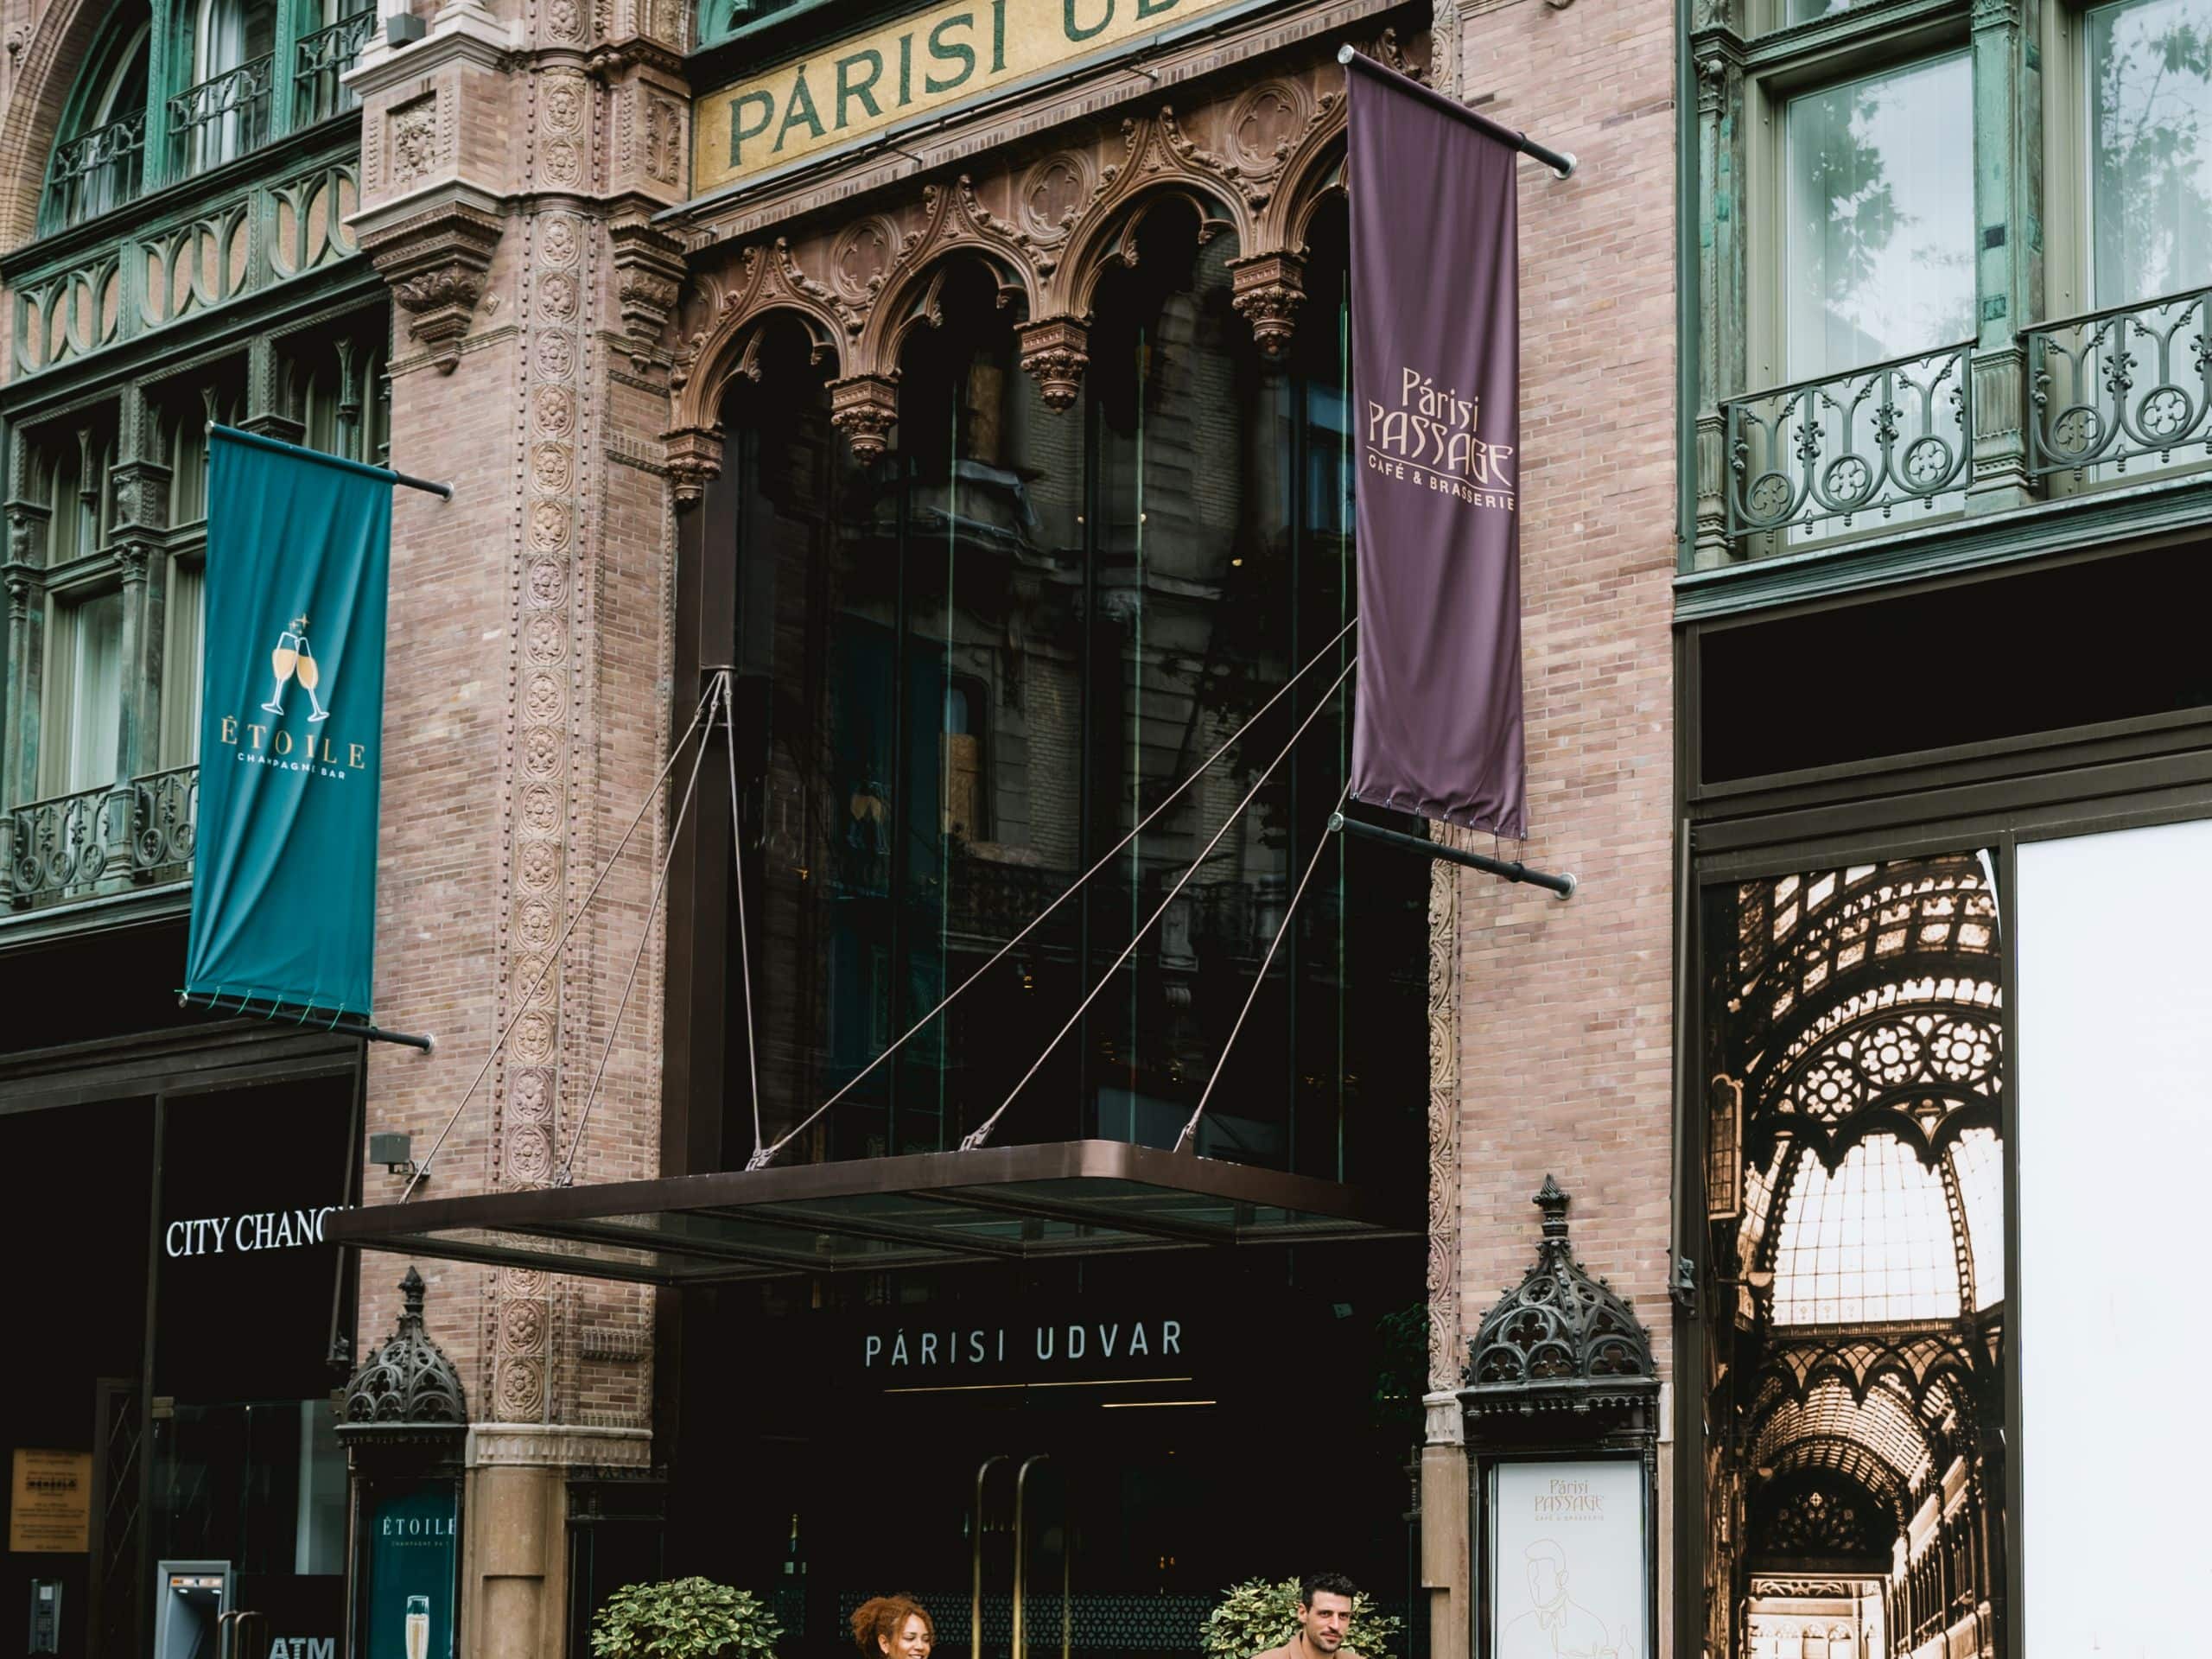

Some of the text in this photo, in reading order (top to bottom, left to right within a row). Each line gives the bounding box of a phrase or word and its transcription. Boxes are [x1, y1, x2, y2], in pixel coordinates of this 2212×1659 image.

[728, 0, 1007, 168] PÁRISI
[1402, 367, 1479, 433] Párisi
[1369, 398, 1514, 487] PASSAGE
[1368, 454, 1515, 512] CAFÉ & BRASSERIE
[321, 766, 346, 779] BAR
[166, 1205, 354, 1258] CITY CHAN
[865, 1320, 1181, 1368] PÁRISI UDVAR
[269, 1637, 335, 1659] ATM
